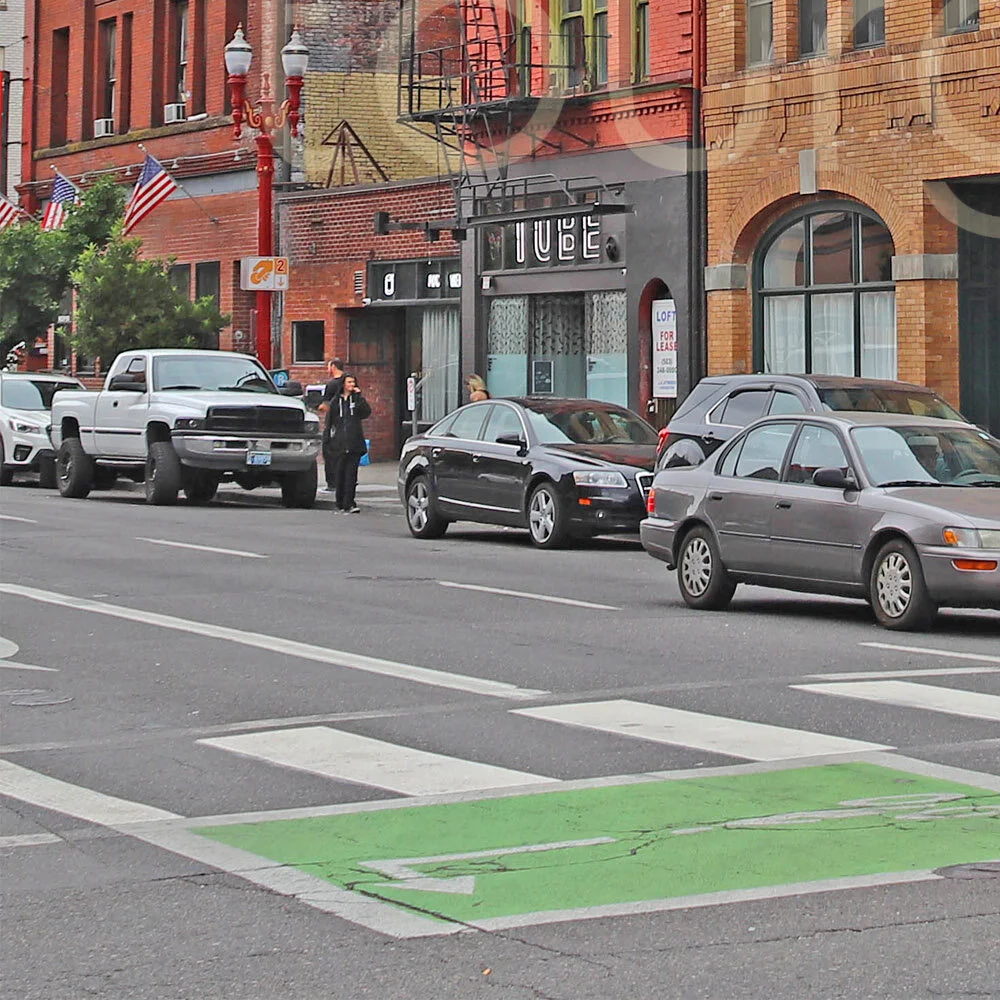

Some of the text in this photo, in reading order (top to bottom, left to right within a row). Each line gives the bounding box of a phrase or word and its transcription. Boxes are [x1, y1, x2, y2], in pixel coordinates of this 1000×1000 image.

[515, 215, 600, 264] TUBE
[277, 260, 284, 271] 2
[660, 331, 674, 340] FOR
[656, 342, 678, 351] LEASE
